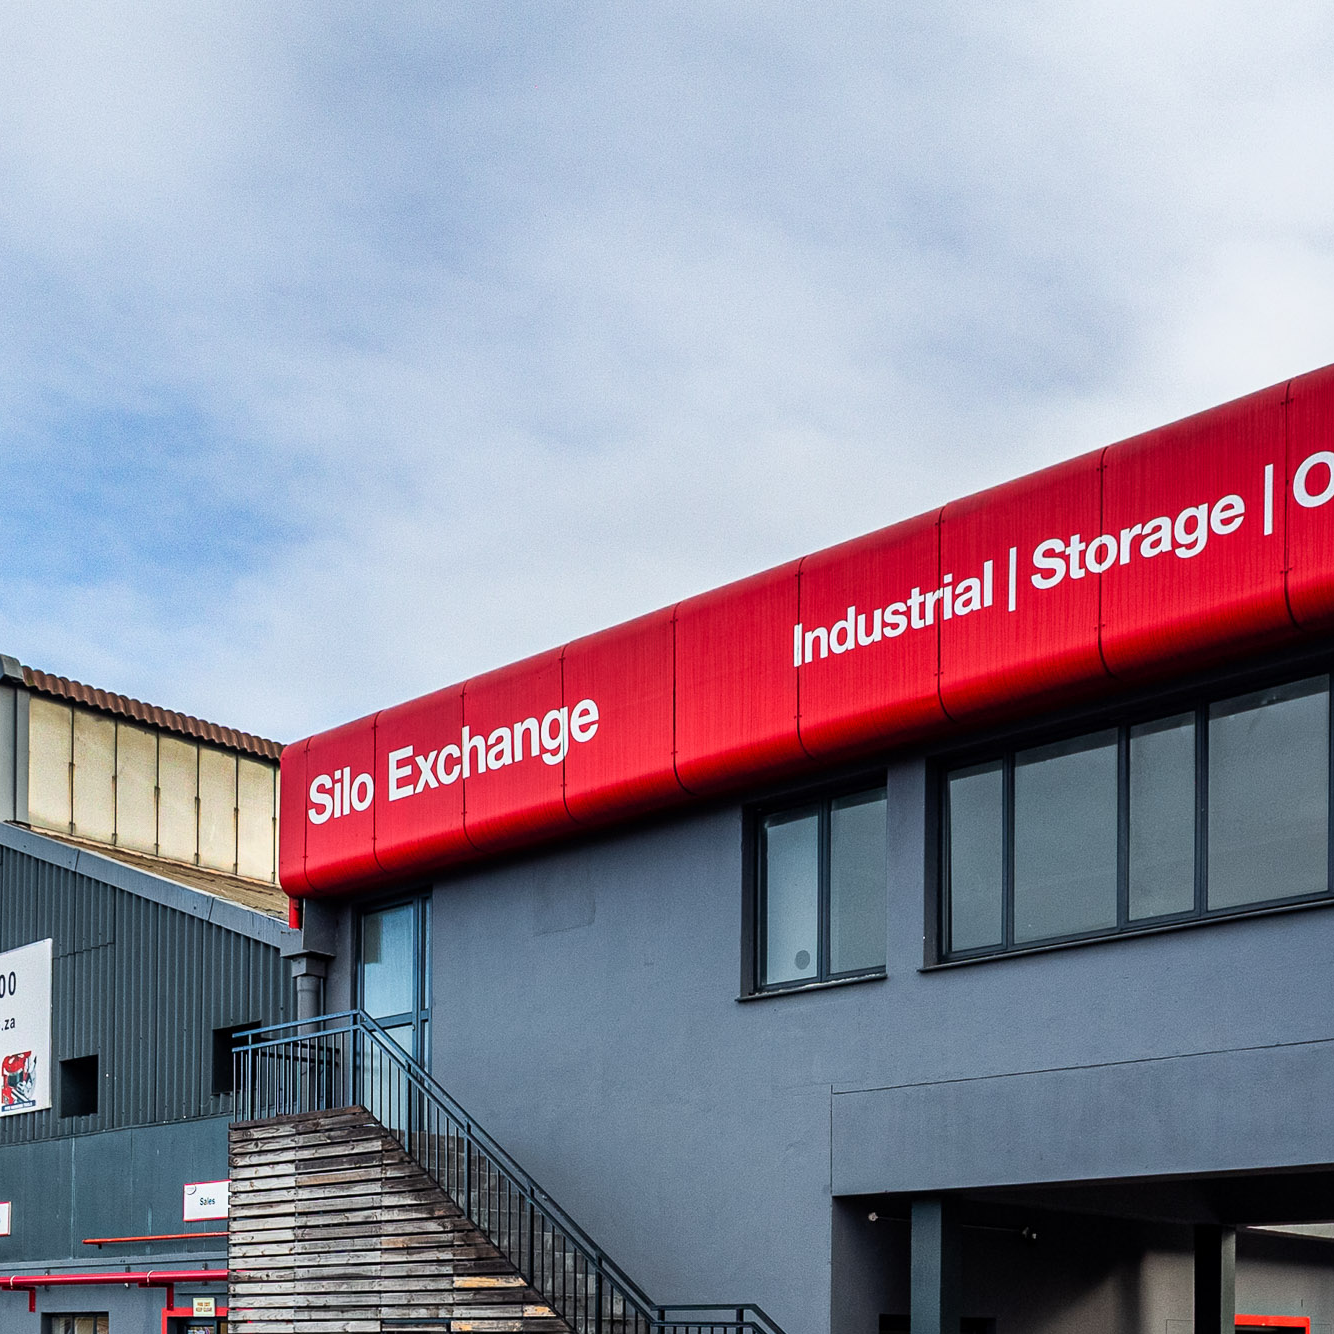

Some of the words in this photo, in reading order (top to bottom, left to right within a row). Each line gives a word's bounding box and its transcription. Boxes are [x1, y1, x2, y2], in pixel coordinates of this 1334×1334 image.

[794, 560, 994, 668] Industrial
[1031, 492, 1246, 591] Storage
[307, 766, 375, 825] Silo
[387, 698, 600, 802] Exchange
[199, 1197, 216, 1206] Sales
